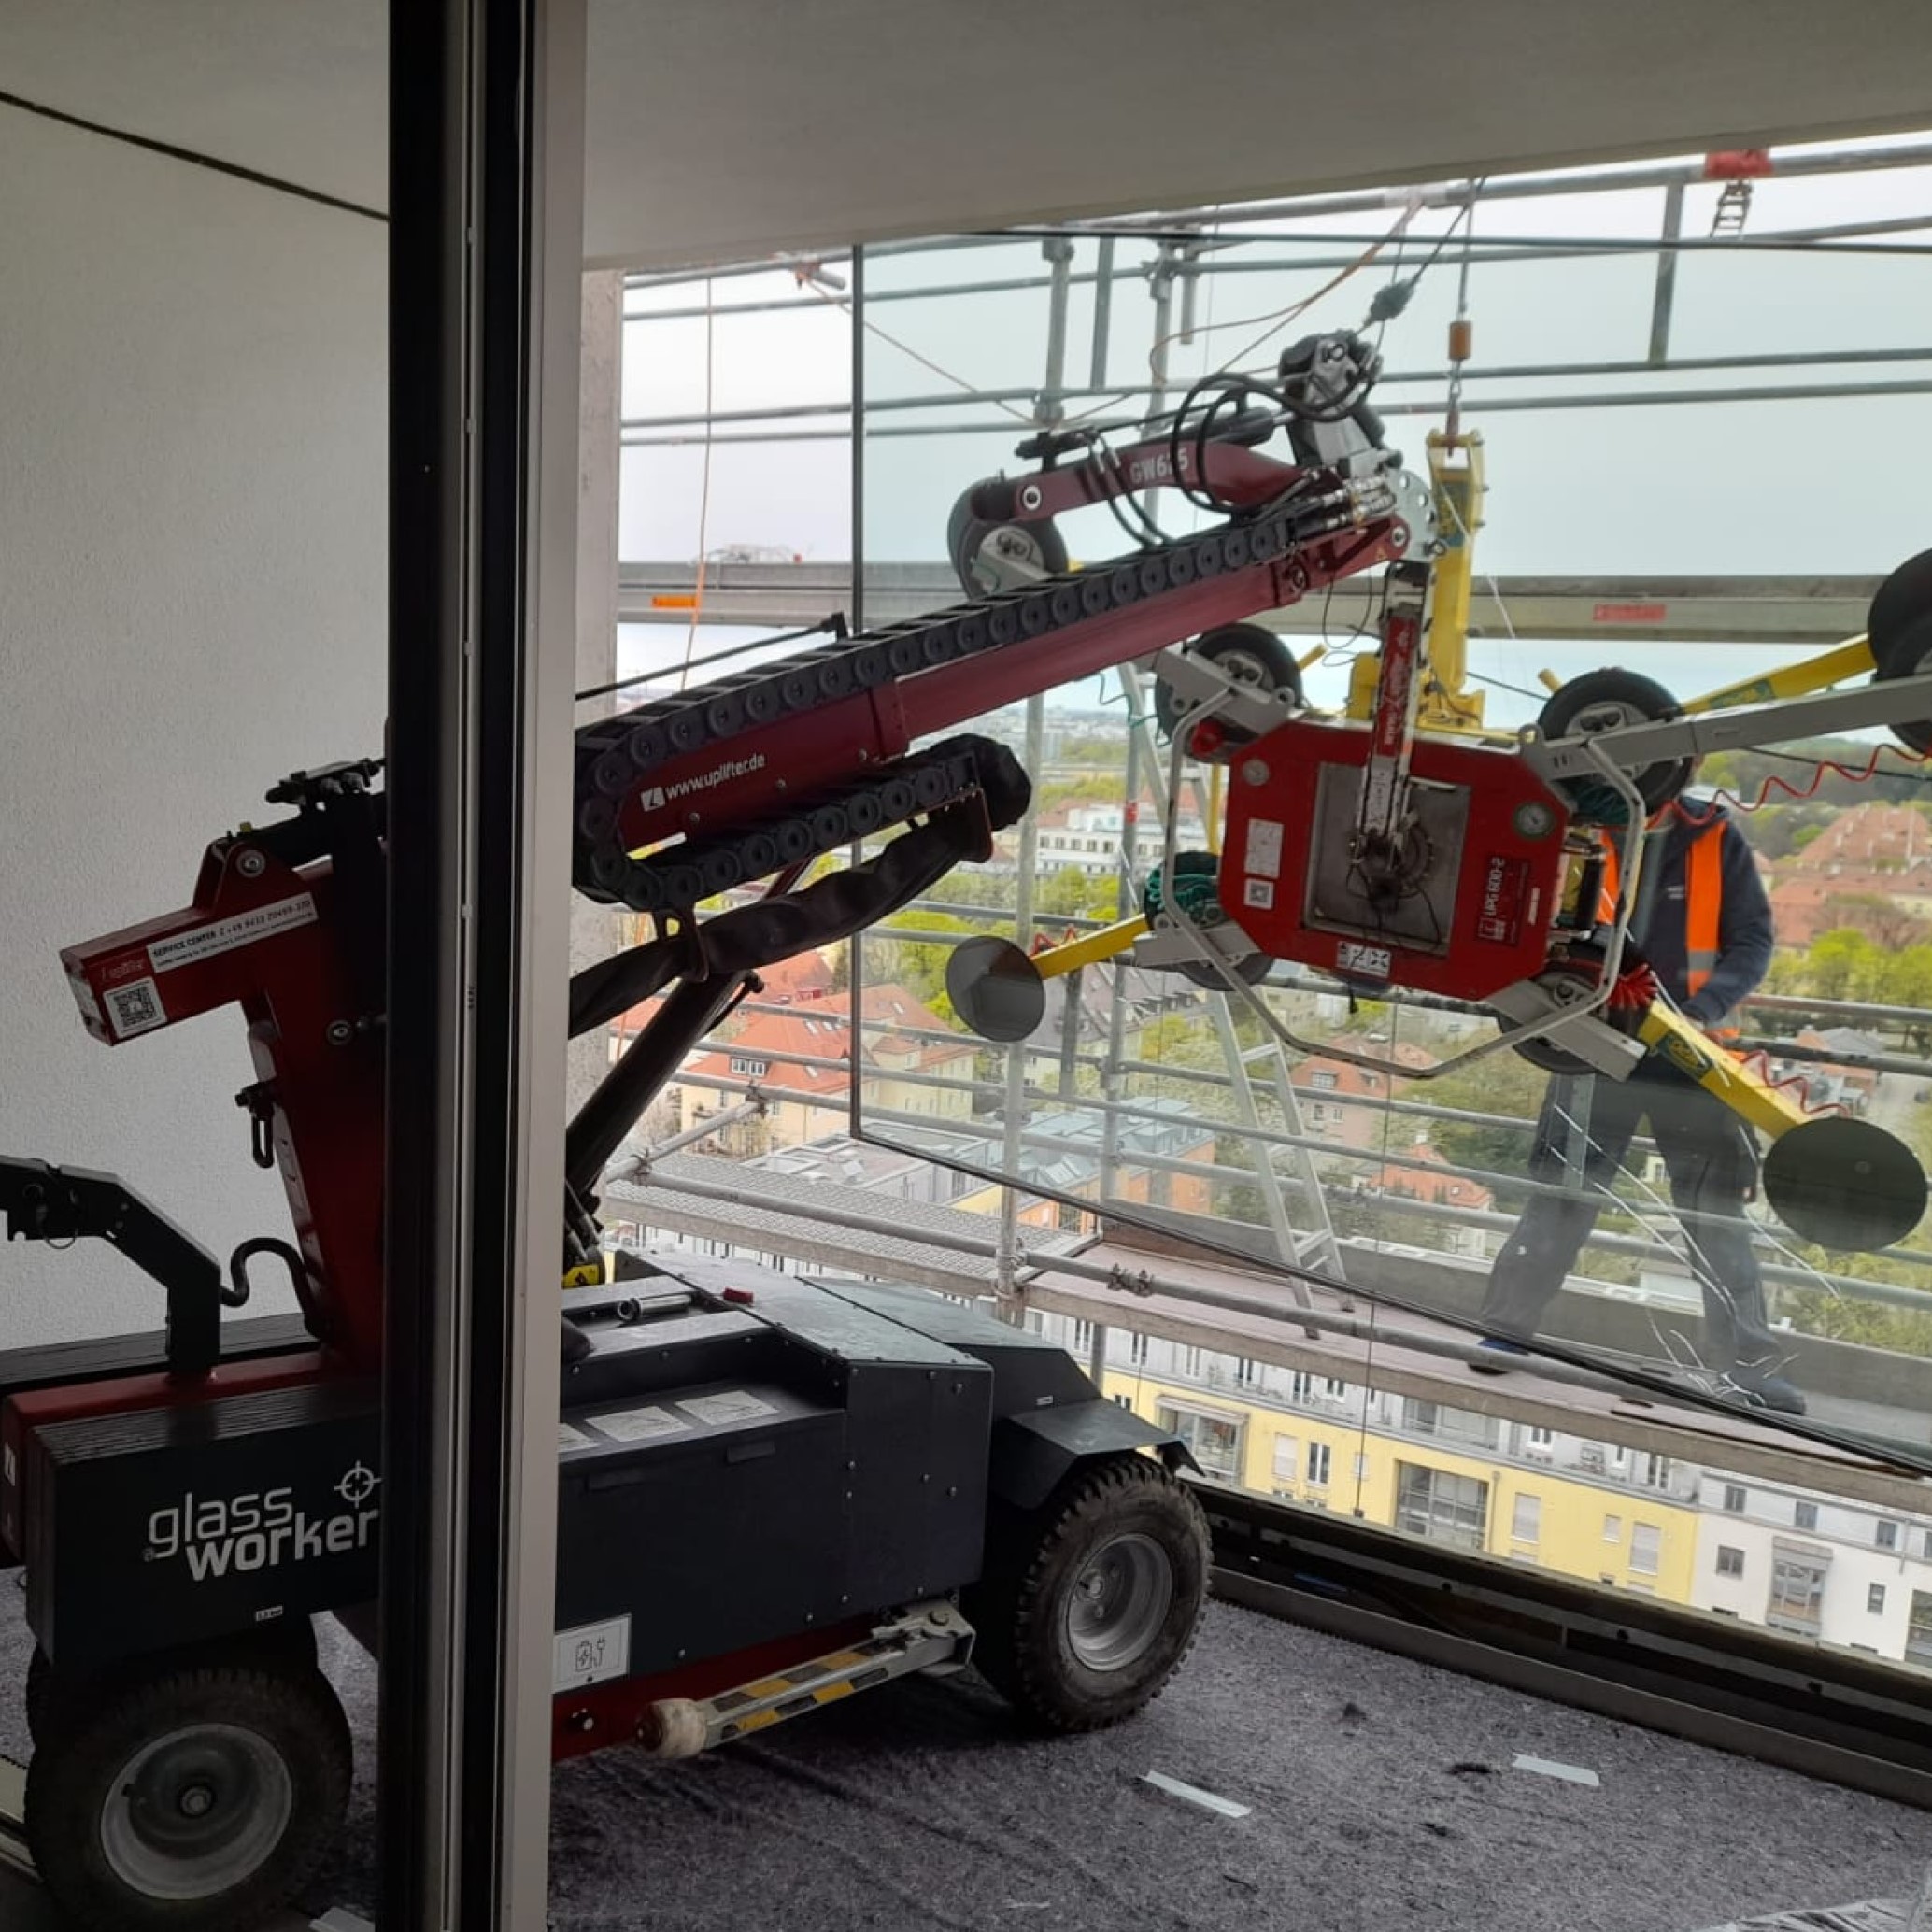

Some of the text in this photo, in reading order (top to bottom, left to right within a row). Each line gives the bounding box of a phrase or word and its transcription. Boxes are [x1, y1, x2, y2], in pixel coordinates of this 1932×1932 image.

[664, 753, 765, 801] www.uplifter.de
[149, 1486, 293, 1559] glass
[187, 1509, 378, 1581] worker
